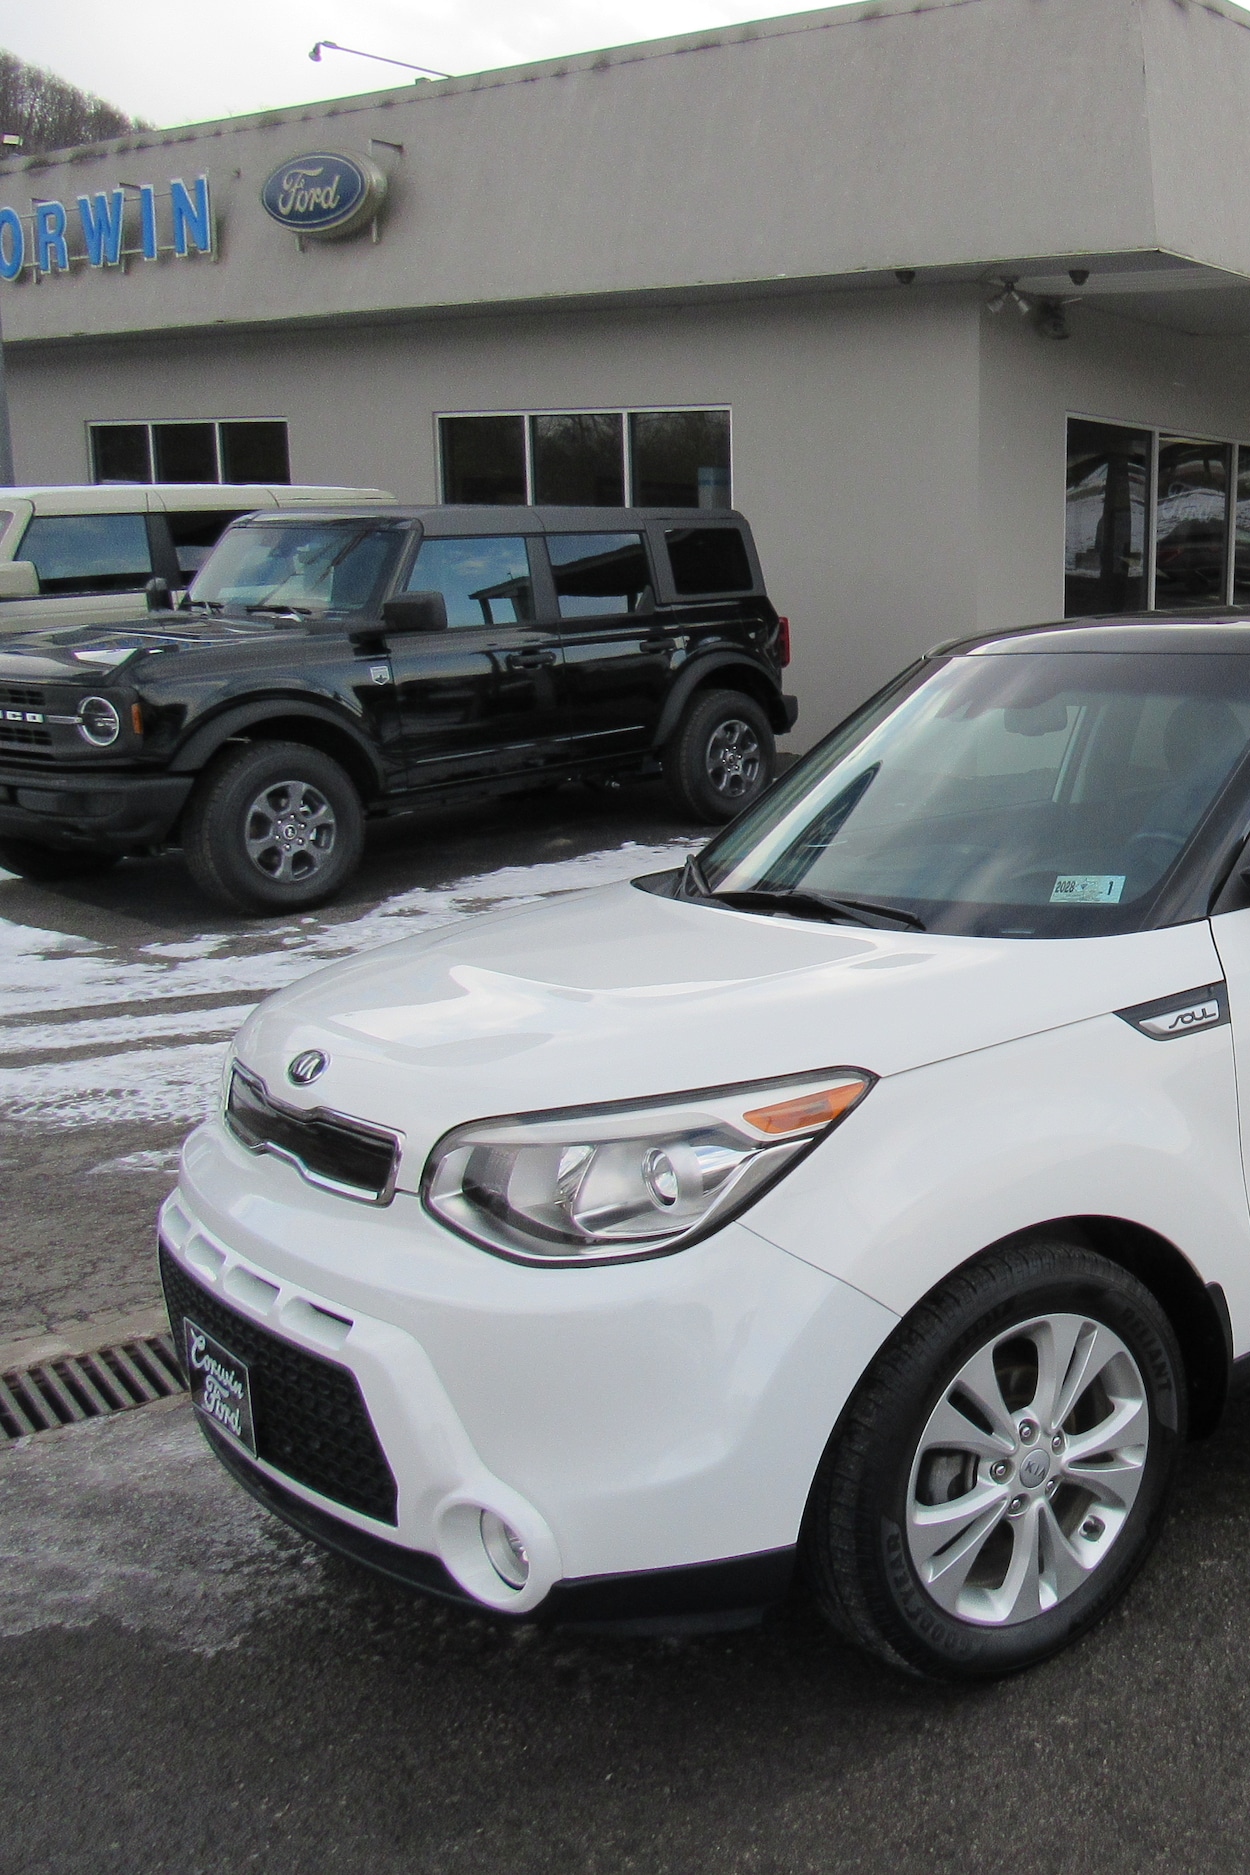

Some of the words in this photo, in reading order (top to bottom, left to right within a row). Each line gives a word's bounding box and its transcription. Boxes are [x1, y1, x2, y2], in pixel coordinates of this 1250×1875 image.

[278, 166, 343, 216] Ford
[1107, 880, 1115, 896] 1
[1168, 1007, 1217, 1029] SOUL
[190, 1327, 245, 1400] Corwin
[203, 1374, 242, 1437] Ford
[1024, 1460, 1046, 1480] KIA
